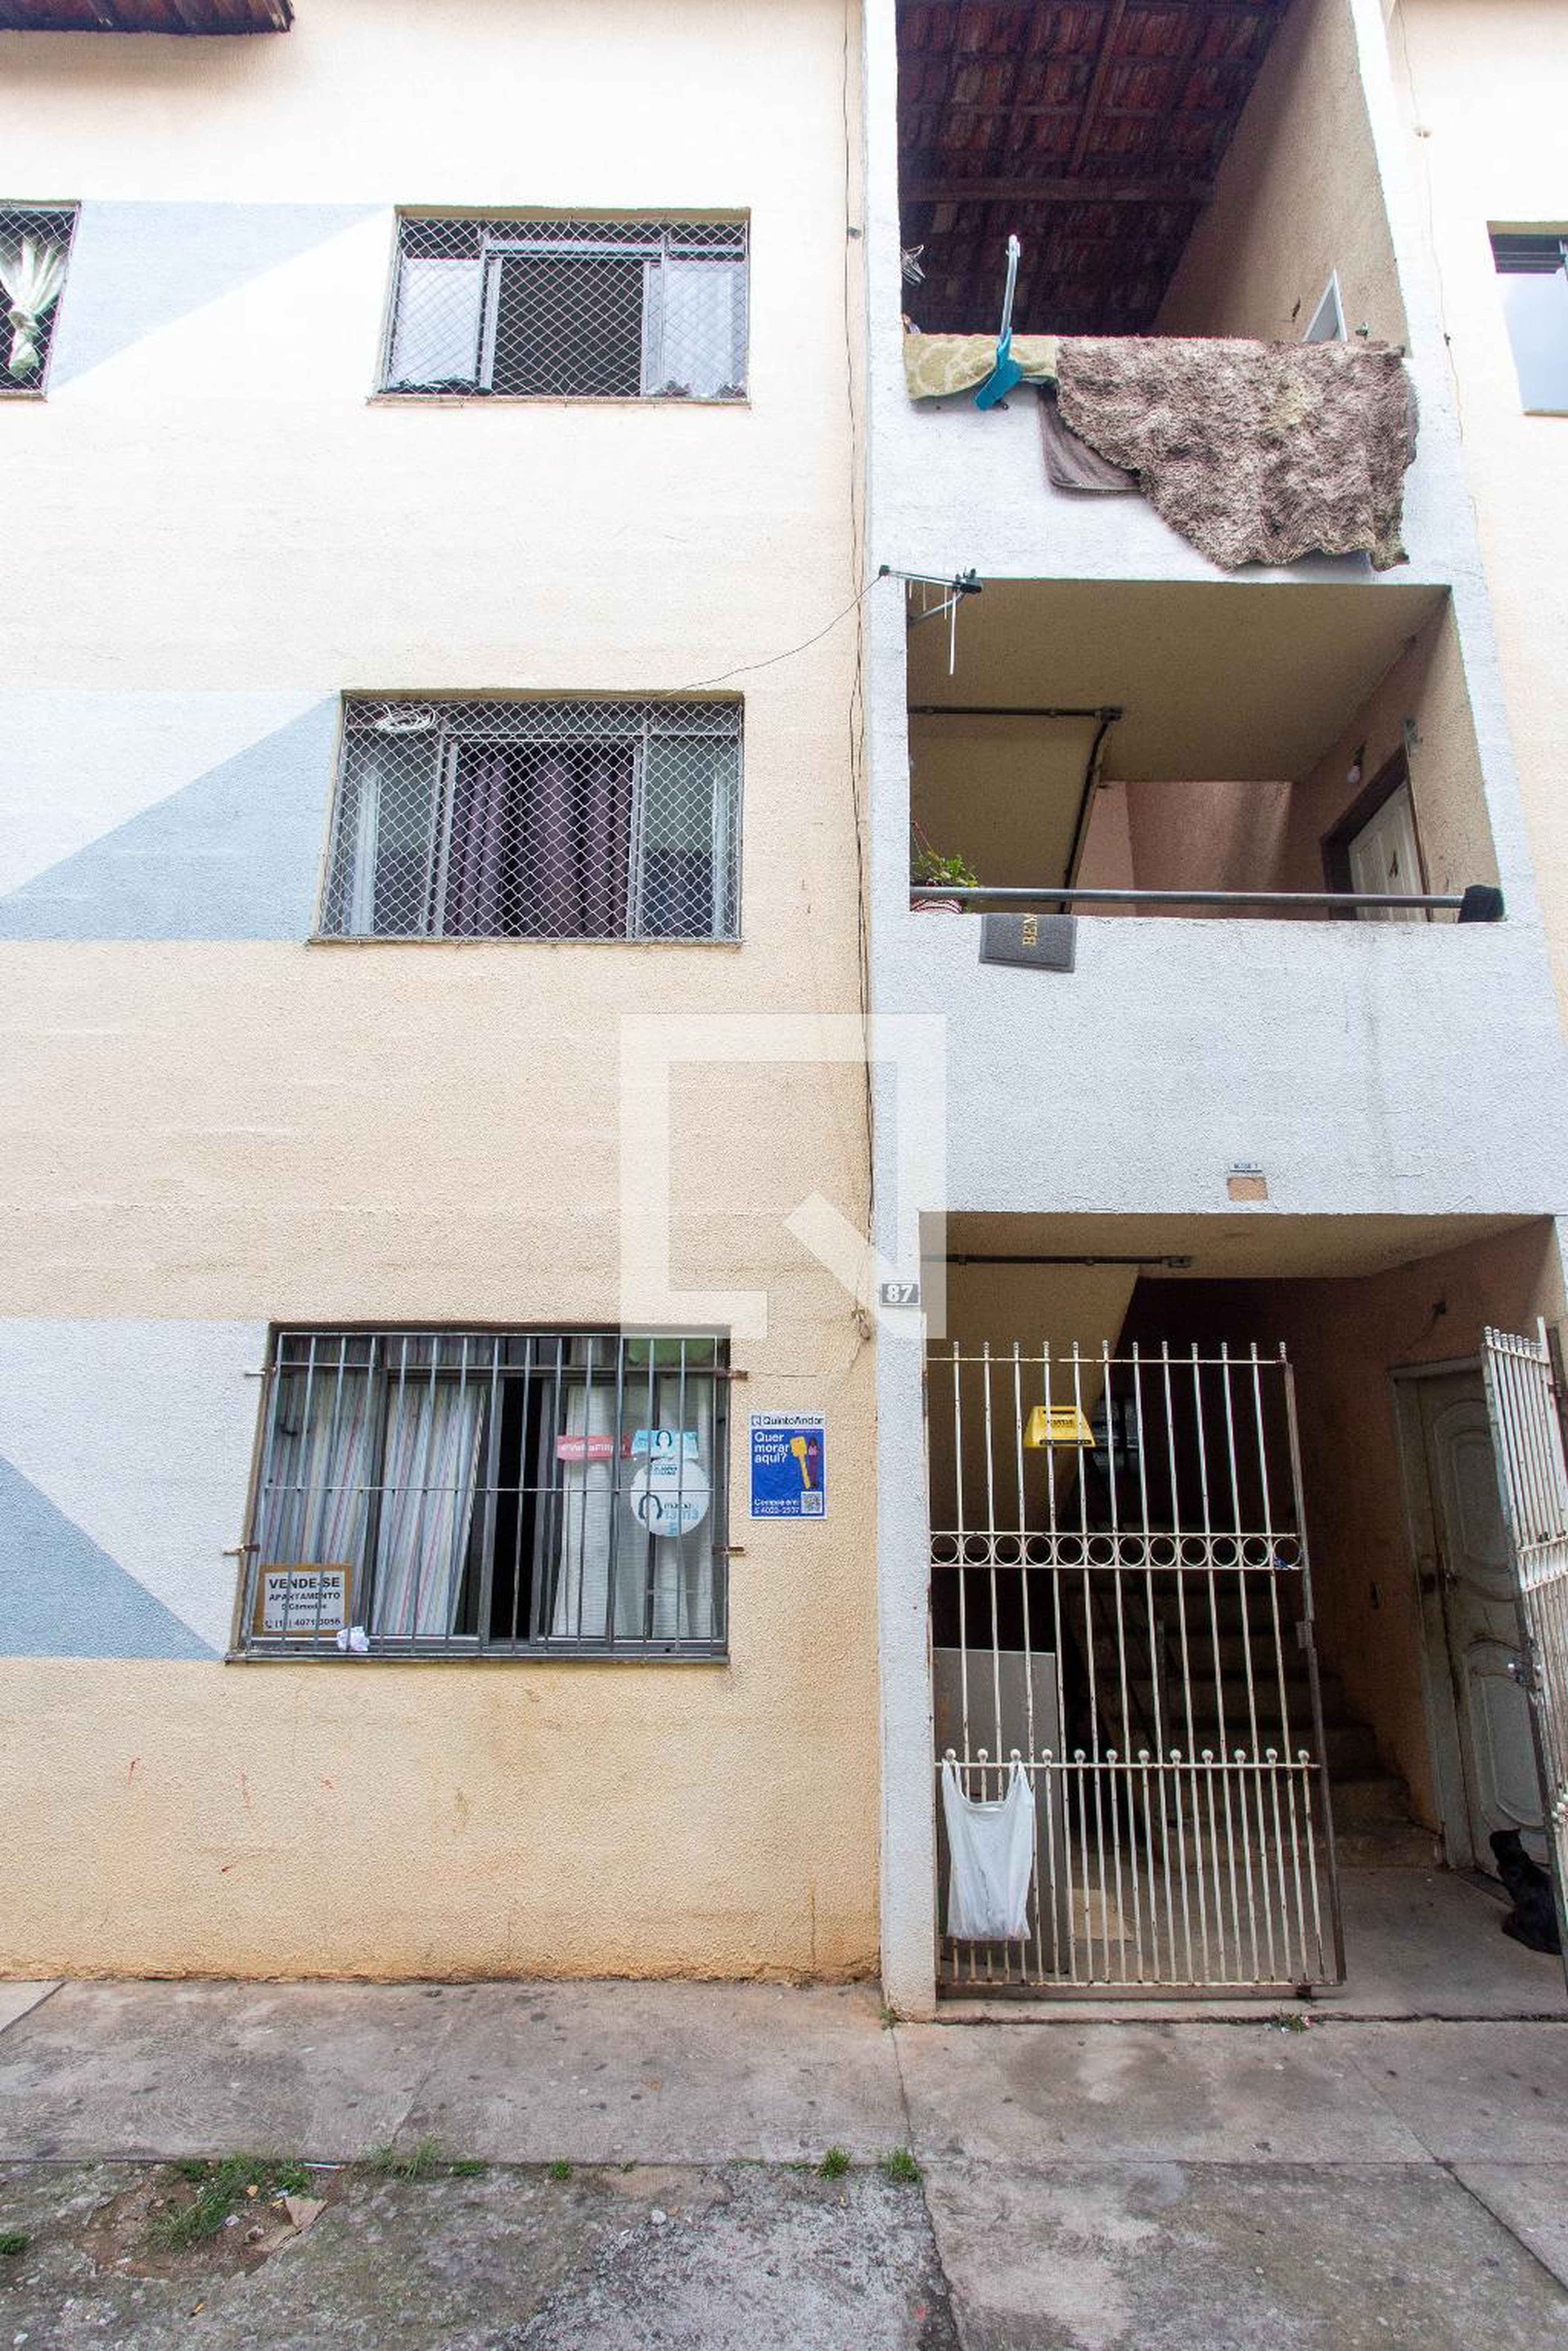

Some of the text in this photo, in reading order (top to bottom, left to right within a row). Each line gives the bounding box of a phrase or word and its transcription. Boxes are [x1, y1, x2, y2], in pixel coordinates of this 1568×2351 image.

[886, 1285, 913, 1302] 87
[763, 1416, 824, 1425] QuintoAndar
[755, 1432, 784, 1443] Quer
[755, 1444, 789, 1452] morar
[755, 1452, 787, 1465] aqui?
[269, 1577, 340, 1589] VENDE-SE
